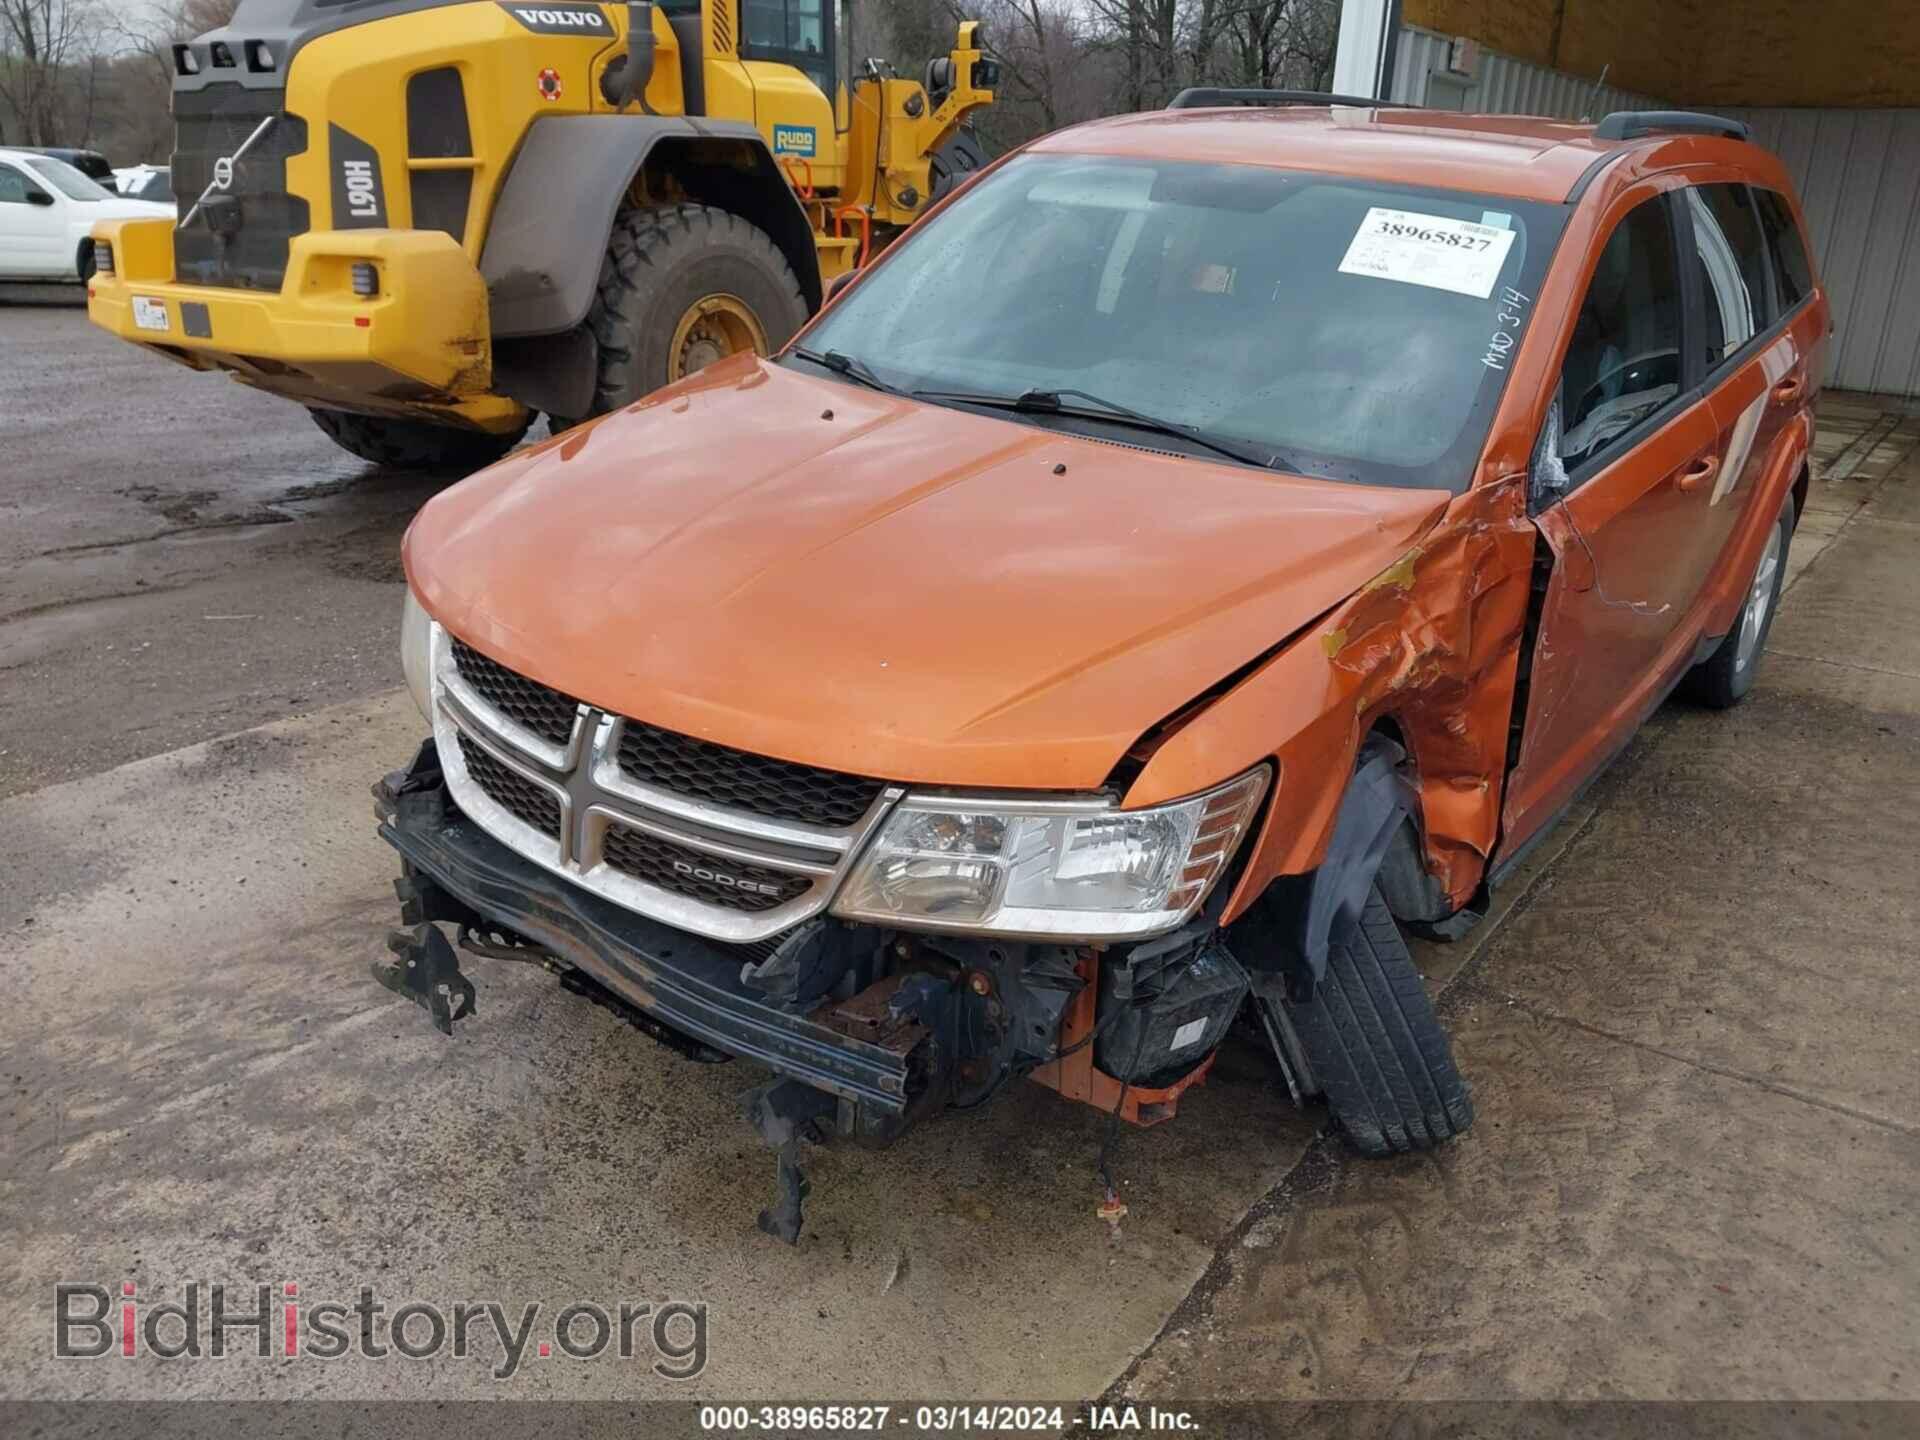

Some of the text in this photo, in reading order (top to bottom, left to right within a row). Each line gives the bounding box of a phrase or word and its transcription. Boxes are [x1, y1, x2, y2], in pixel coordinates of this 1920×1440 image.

[515, 9, 602, 26] VOLVO
[777, 130, 813, 149] RUDD
[344, 161, 377, 216] L90H
[1374, 221, 1492, 252] 38965827
[1497, 286, 1530, 327] 3-14
[674, 861, 780, 896] DODGE
